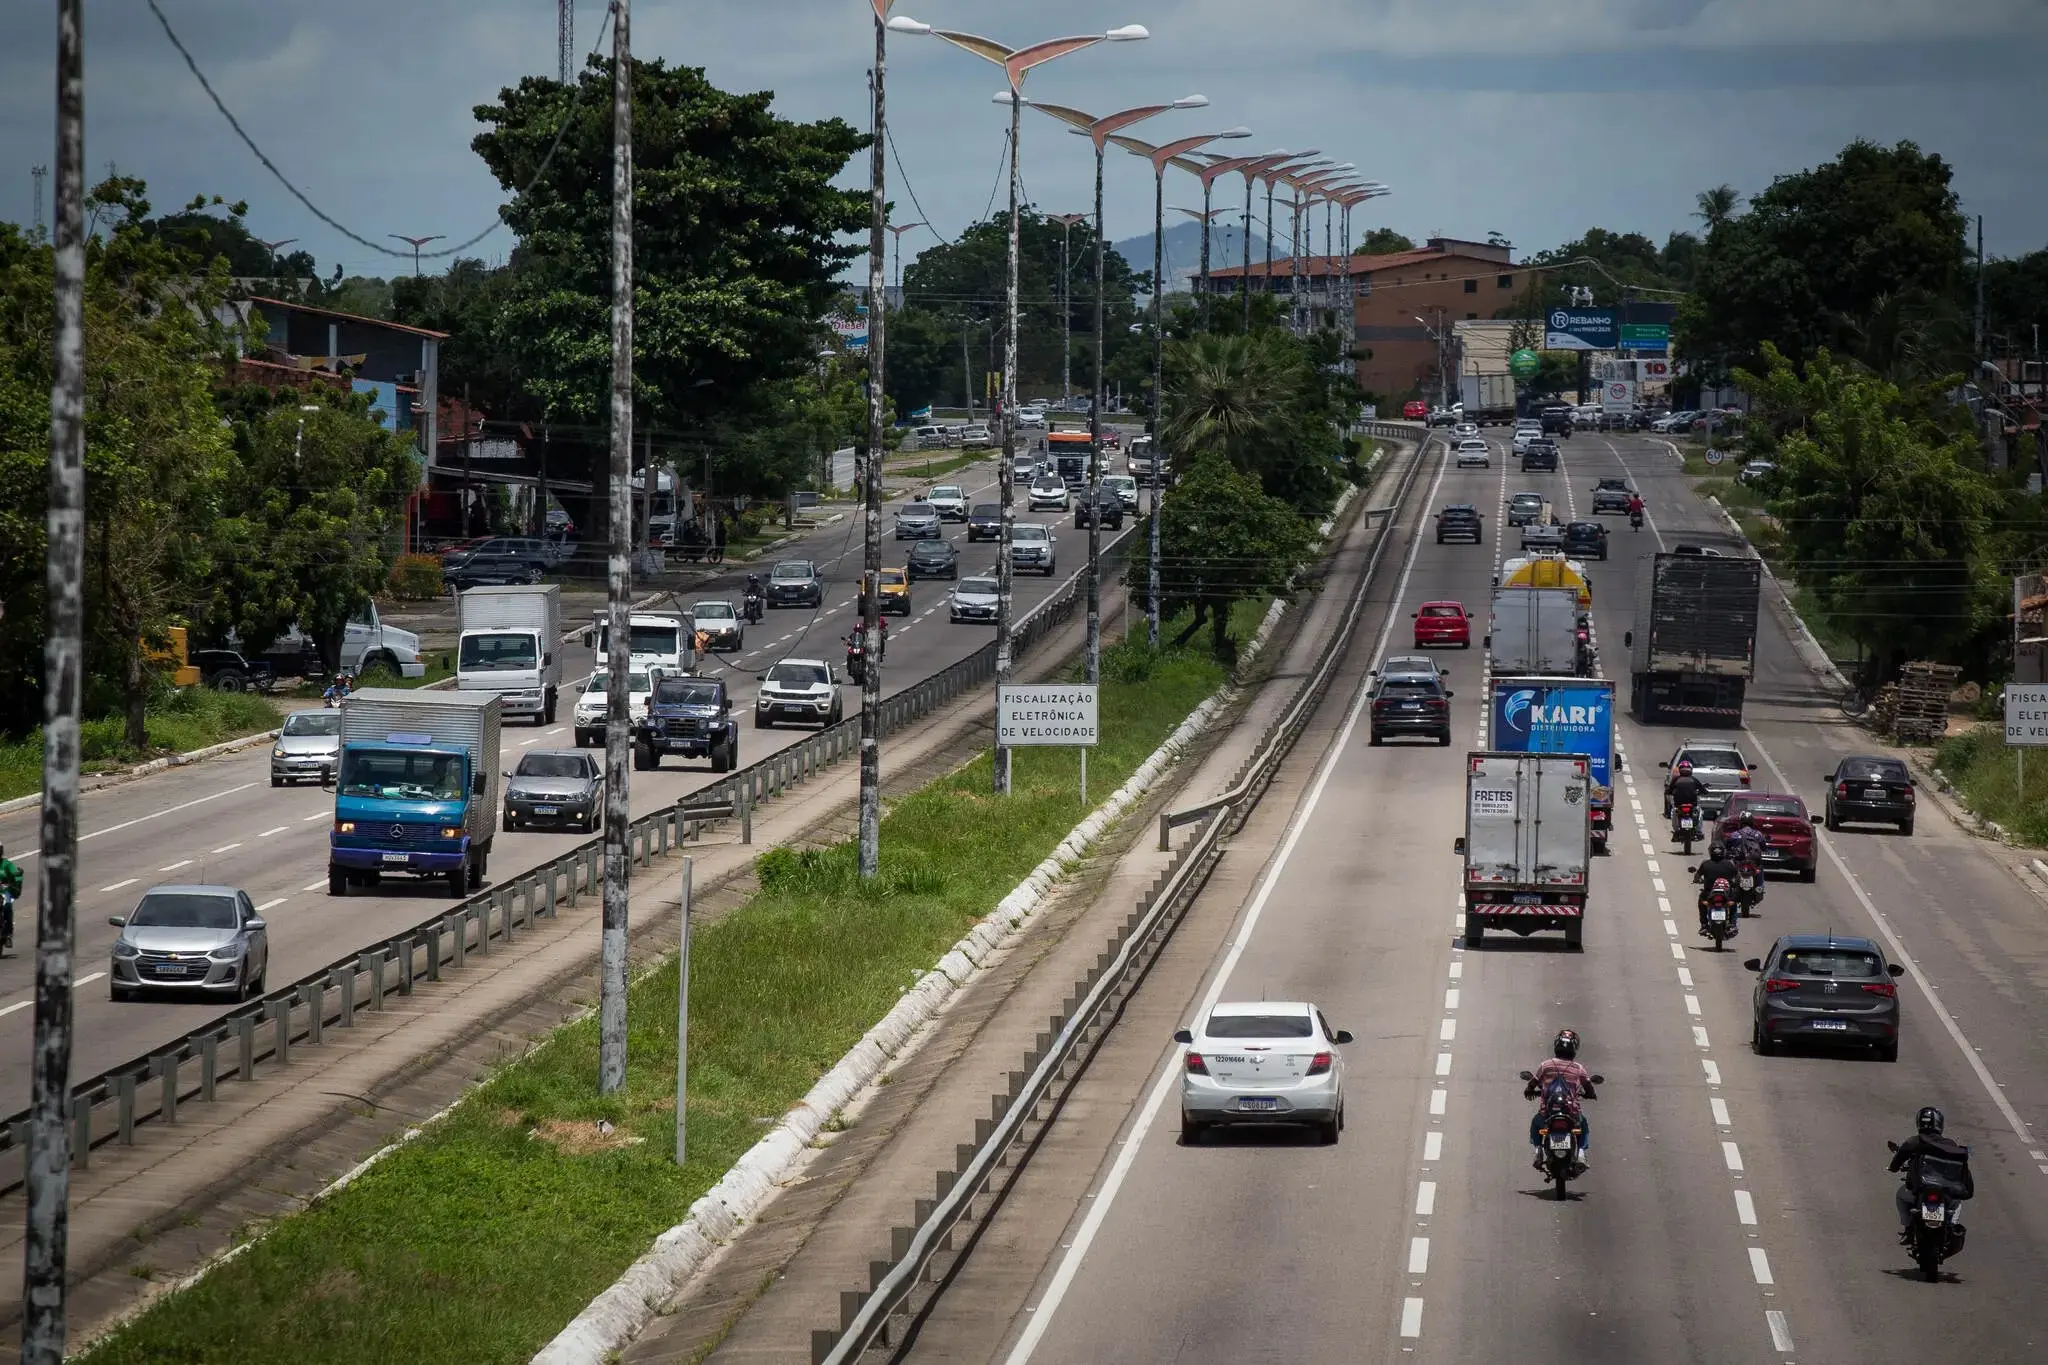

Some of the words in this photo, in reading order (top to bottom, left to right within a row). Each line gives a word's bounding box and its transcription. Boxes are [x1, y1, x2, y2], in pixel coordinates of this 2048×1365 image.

[834, 321, 865, 330] Diesel
[1570, 316, 1611, 325] REBANHO
[1707, 450, 1721, 460] 60
[1004, 692, 1093, 706] FISCALIZAÇÃO
[1012, 709, 1085, 721] ELETRÔNICA
[1531, 705, 1596, 725] KARI
[1001, 727, 1016, 737] DE
[1022, 727, 1095, 737] VELOCIDADE
[1531, 724, 1596, 733] DISTRIUIDORA
[2008, 726, 2023, 737] DE
[1474, 790, 1513, 802] FRETES
